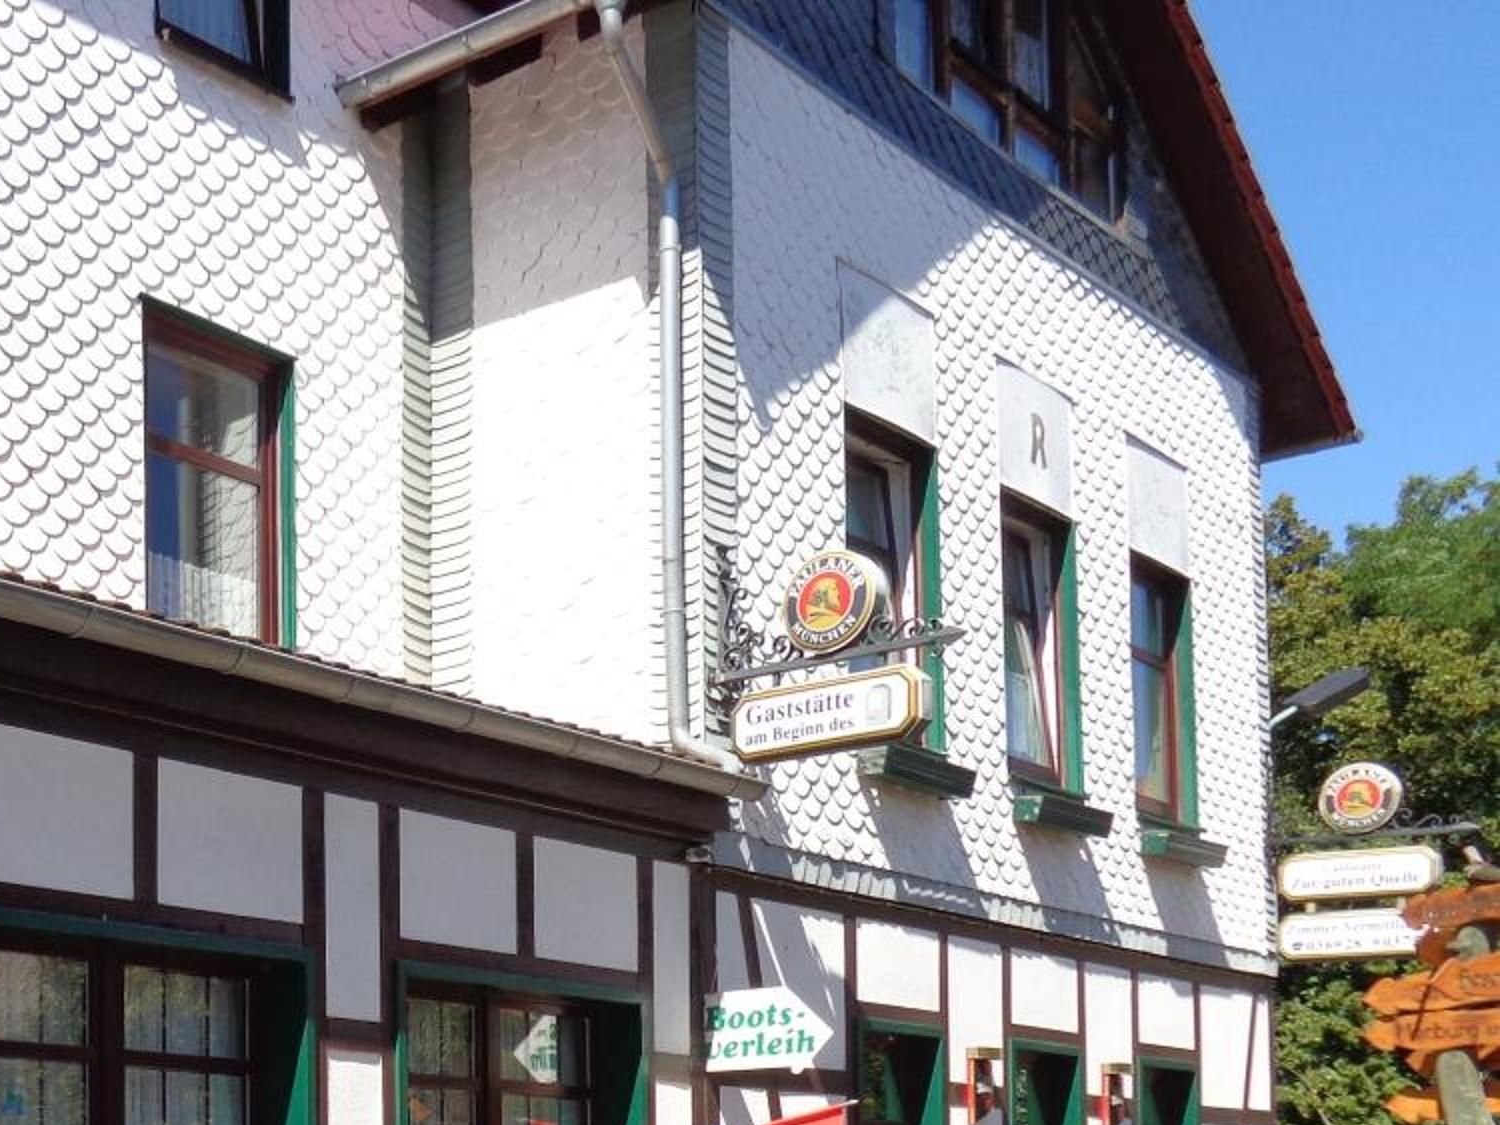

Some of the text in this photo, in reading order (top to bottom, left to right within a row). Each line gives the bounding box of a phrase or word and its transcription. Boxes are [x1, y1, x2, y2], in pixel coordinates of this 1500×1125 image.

[791, 614, 857, 643] MÜNCHEN
[745, 692, 855, 726] Gaststätte
[744, 717, 856, 747] am Beginn des
[706, 1002, 805, 1031] Boots-
[704, 1028, 815, 1059] verleih
